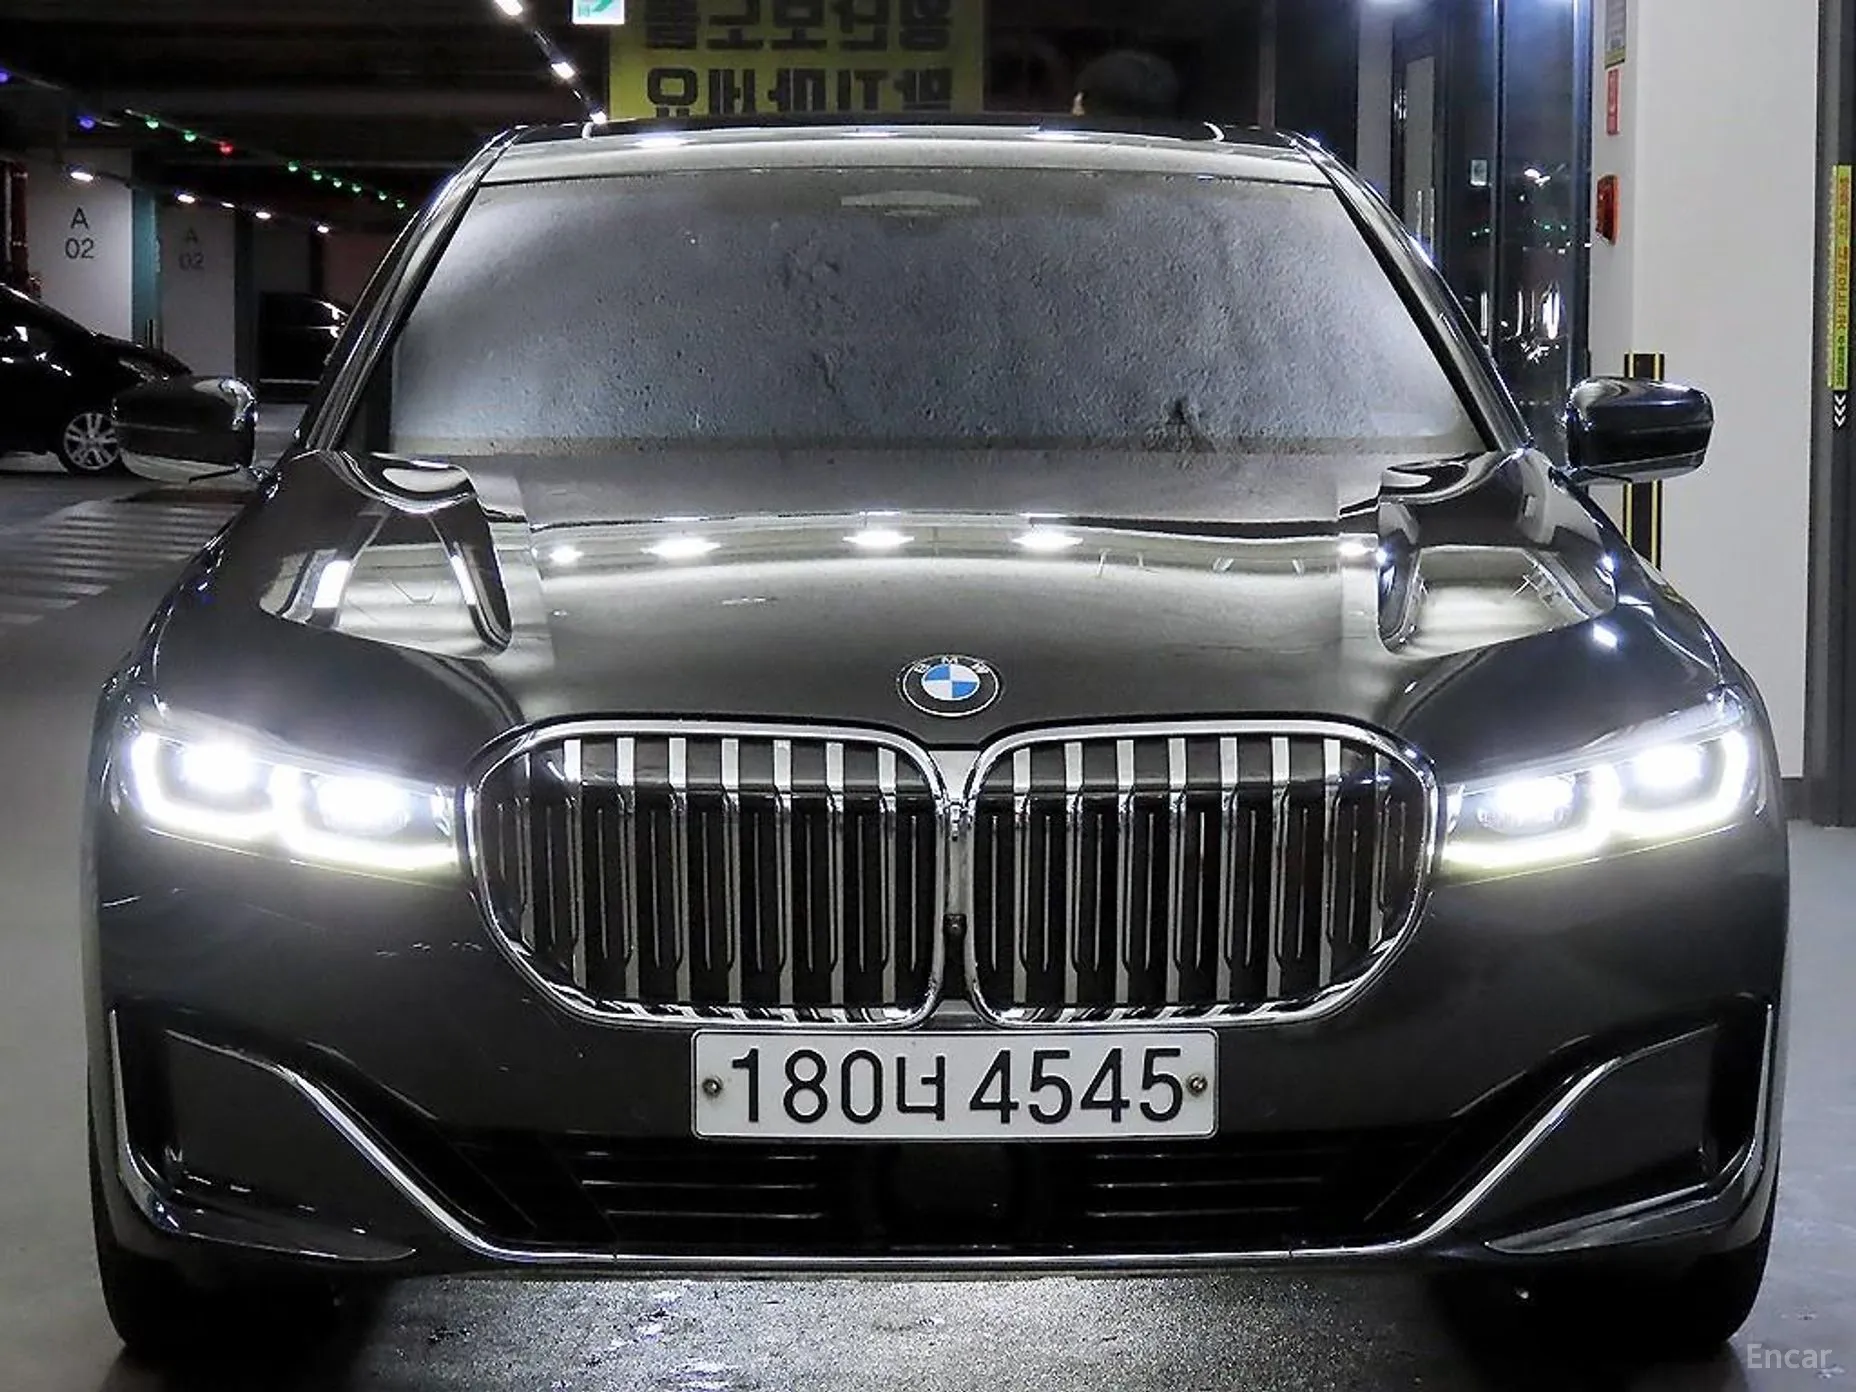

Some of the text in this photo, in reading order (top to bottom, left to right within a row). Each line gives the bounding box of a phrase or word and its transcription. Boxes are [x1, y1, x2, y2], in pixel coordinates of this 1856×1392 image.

[70, 206, 90, 230] A
[64, 237, 95, 260] 02
[730, 1046, 1184, 1125] 180너 4545
